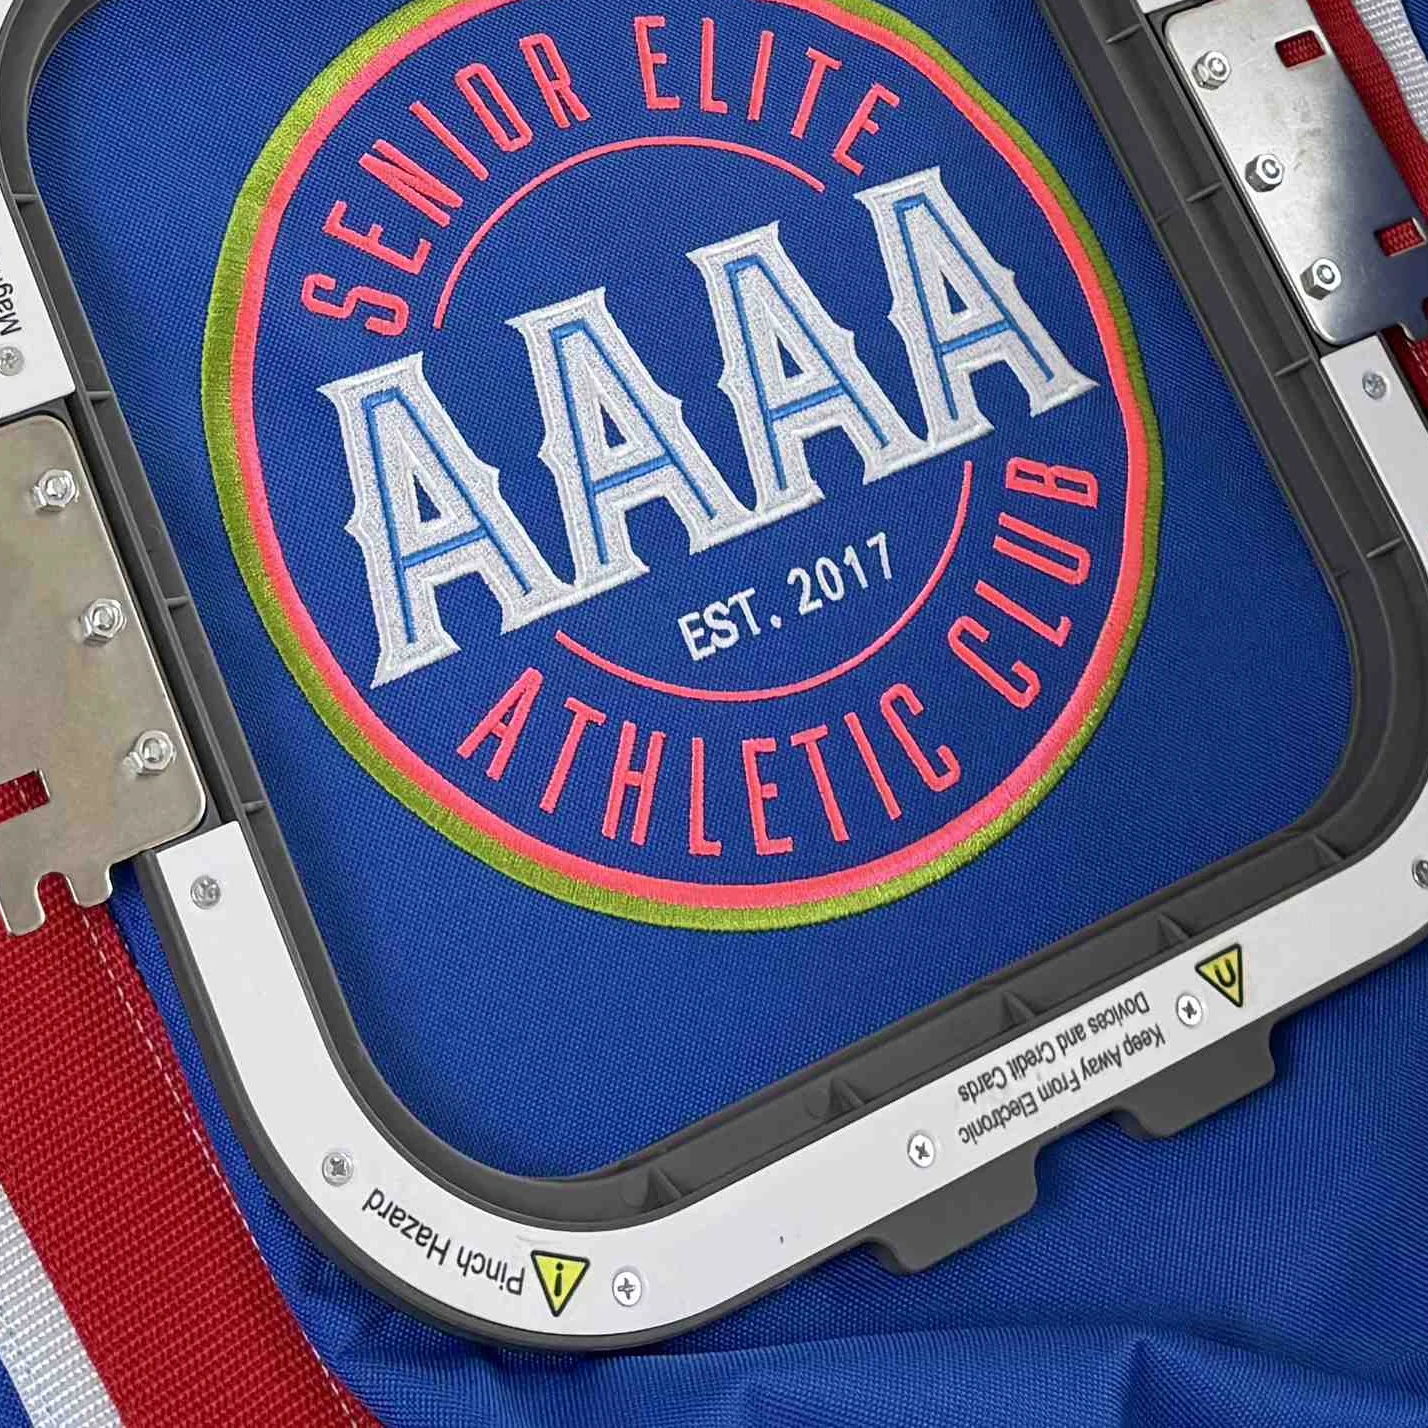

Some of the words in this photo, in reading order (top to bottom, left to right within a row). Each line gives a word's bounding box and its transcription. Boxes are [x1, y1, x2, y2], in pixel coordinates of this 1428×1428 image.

[302, 32, 591, 337] SENIOR
[635, 15, 901, 177] ELITE
[318, 164, 1101, 691] AAAA
[678, 585, 784, 661] EST.
[787, 530, 896, 619] 2017
[456, 667, 964, 858] ATHLETIC
[947, 454, 1101, 709] CLUB
[1006, 1041, 1056, 1081] Credit
[1056, 1024, 1087, 1057] and
[1080, 1045, 1123, 1080] Away
[1125, 1023, 1166, 1057] Keep
[958, 1066, 1008, 1104] Cards
[1037, 1068, 1082, 1102] From
[958, 1091, 1039, 1145] Electronic
[361, 1187, 451, 1266] Hazard
[456, 1246, 525, 1295] Pinch
